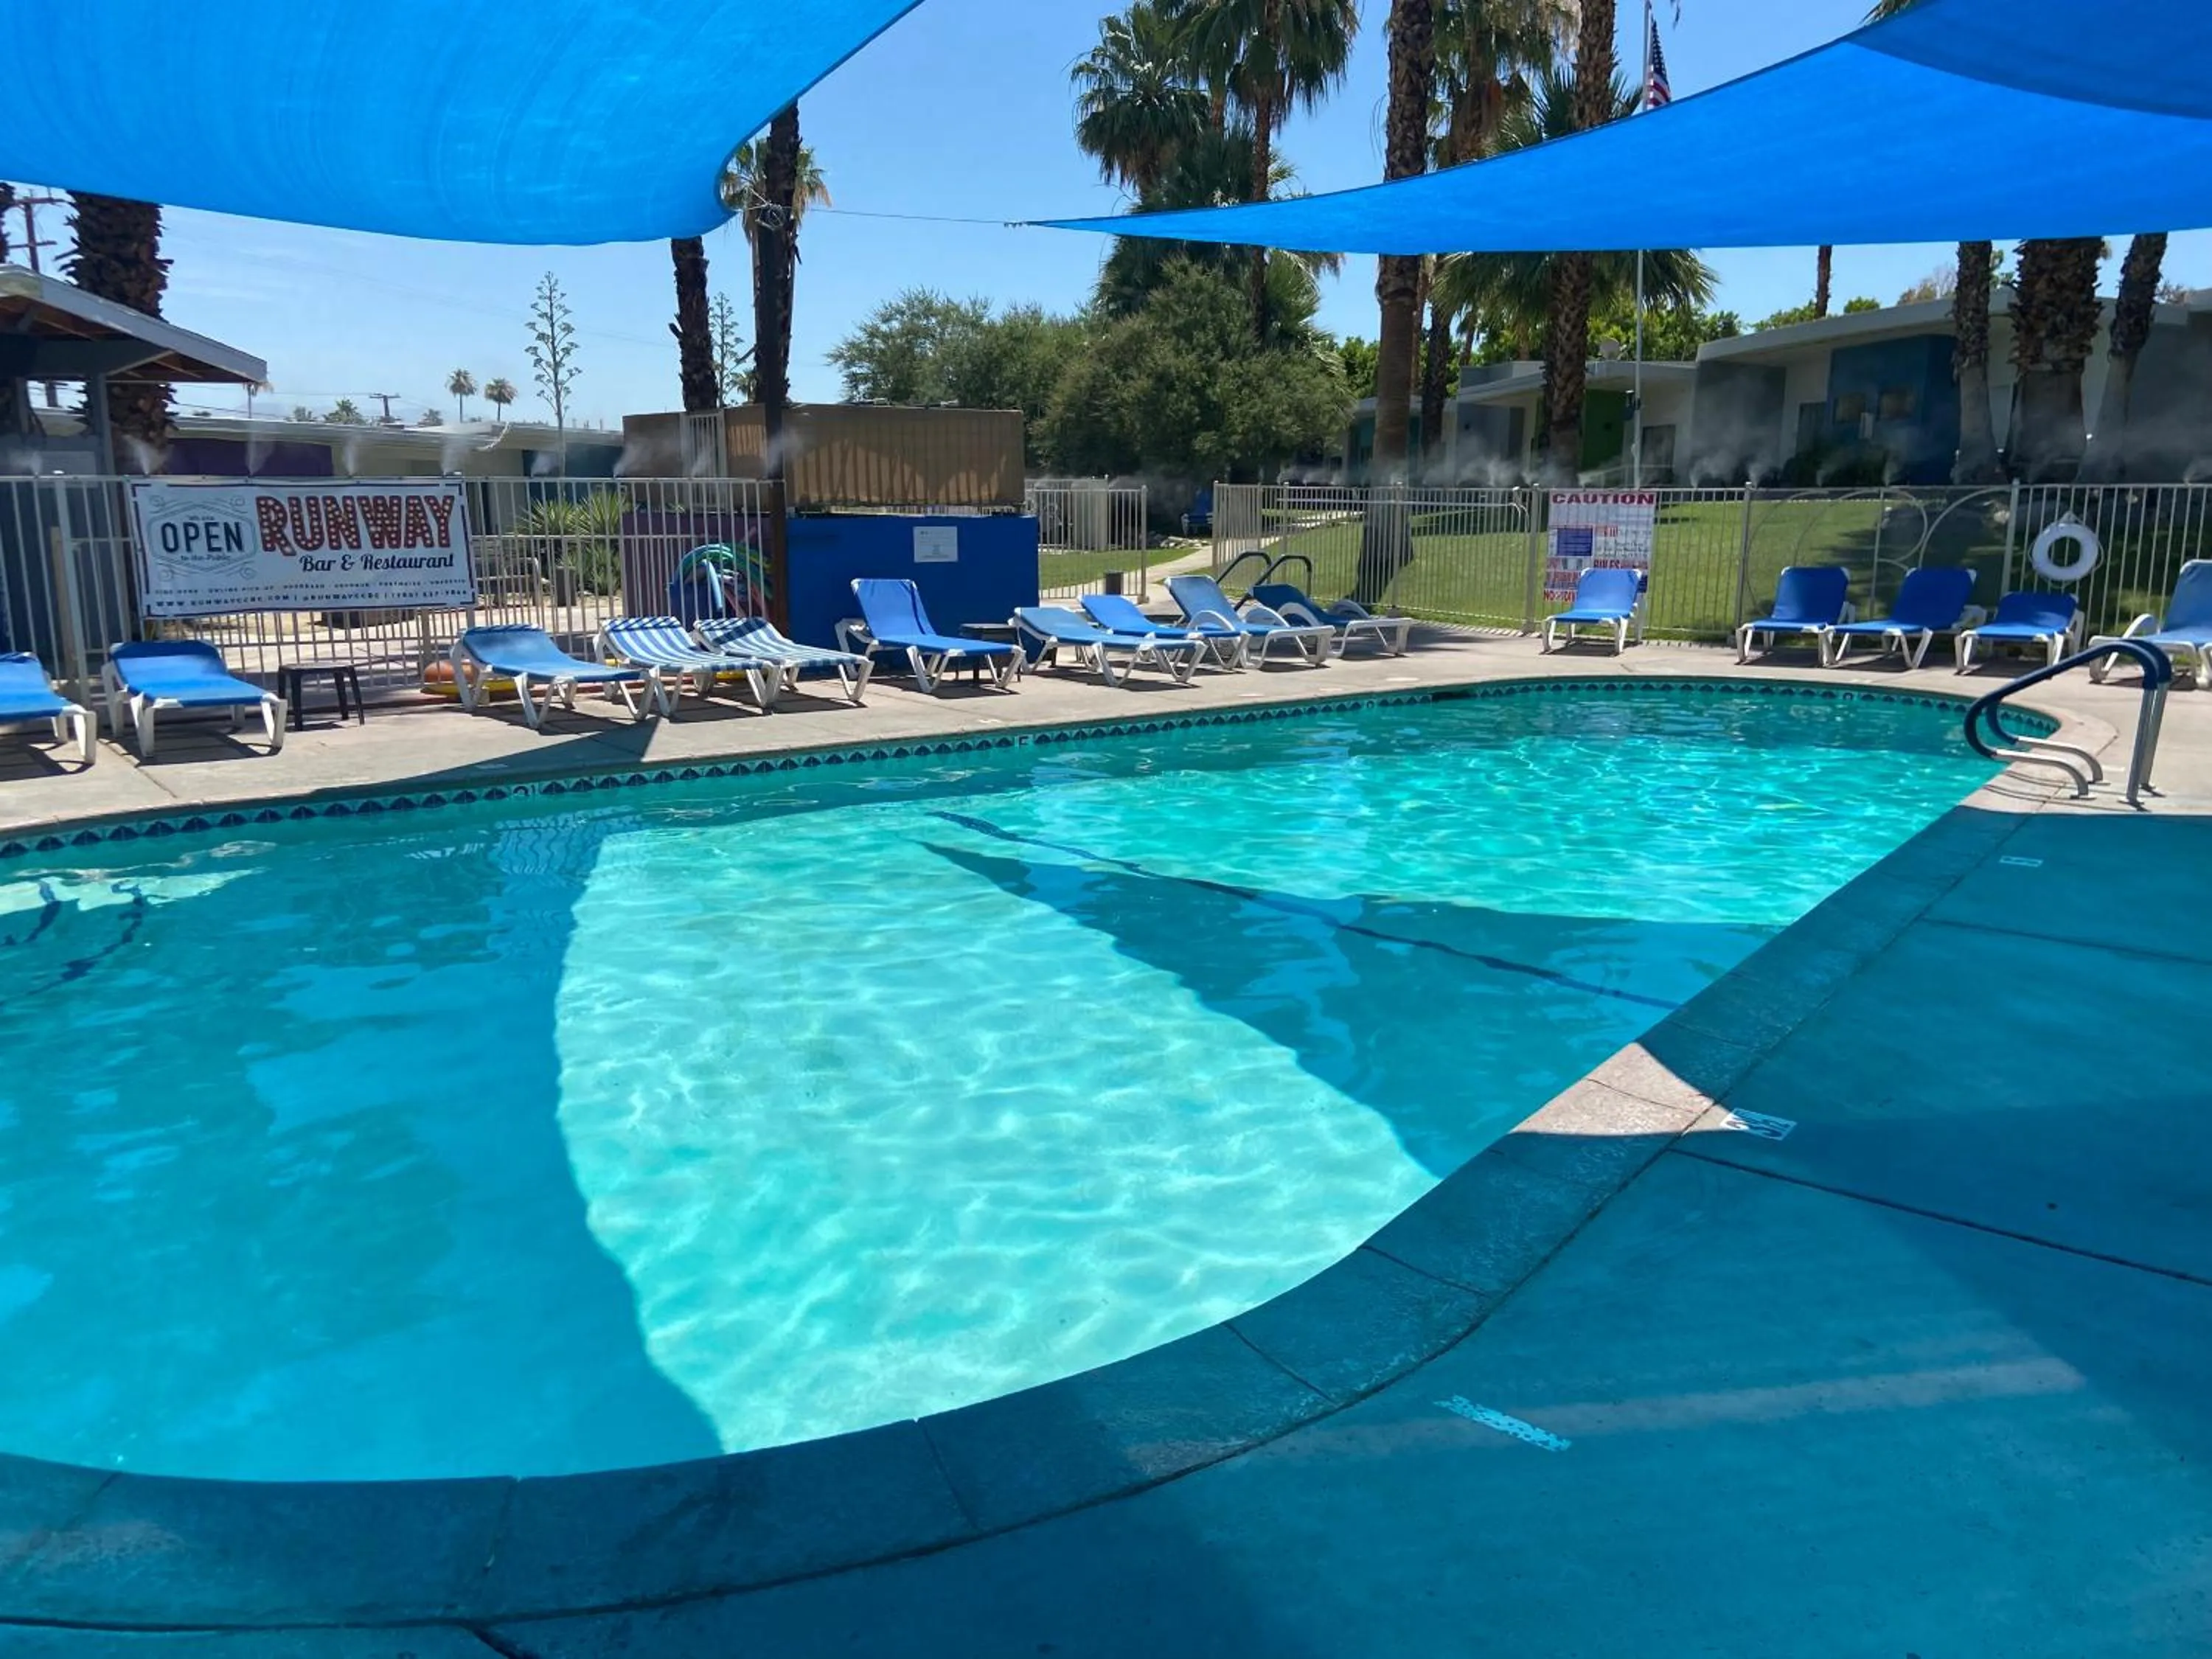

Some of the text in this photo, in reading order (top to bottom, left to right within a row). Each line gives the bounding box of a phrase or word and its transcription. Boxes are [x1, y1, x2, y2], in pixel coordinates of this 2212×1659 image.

[1552, 493, 1655, 505] CAUTION
[161, 521, 246, 553] OPEN
[255, 495, 456, 557] RUNWAY
[299, 553, 455, 572] Bar & Restaurant
